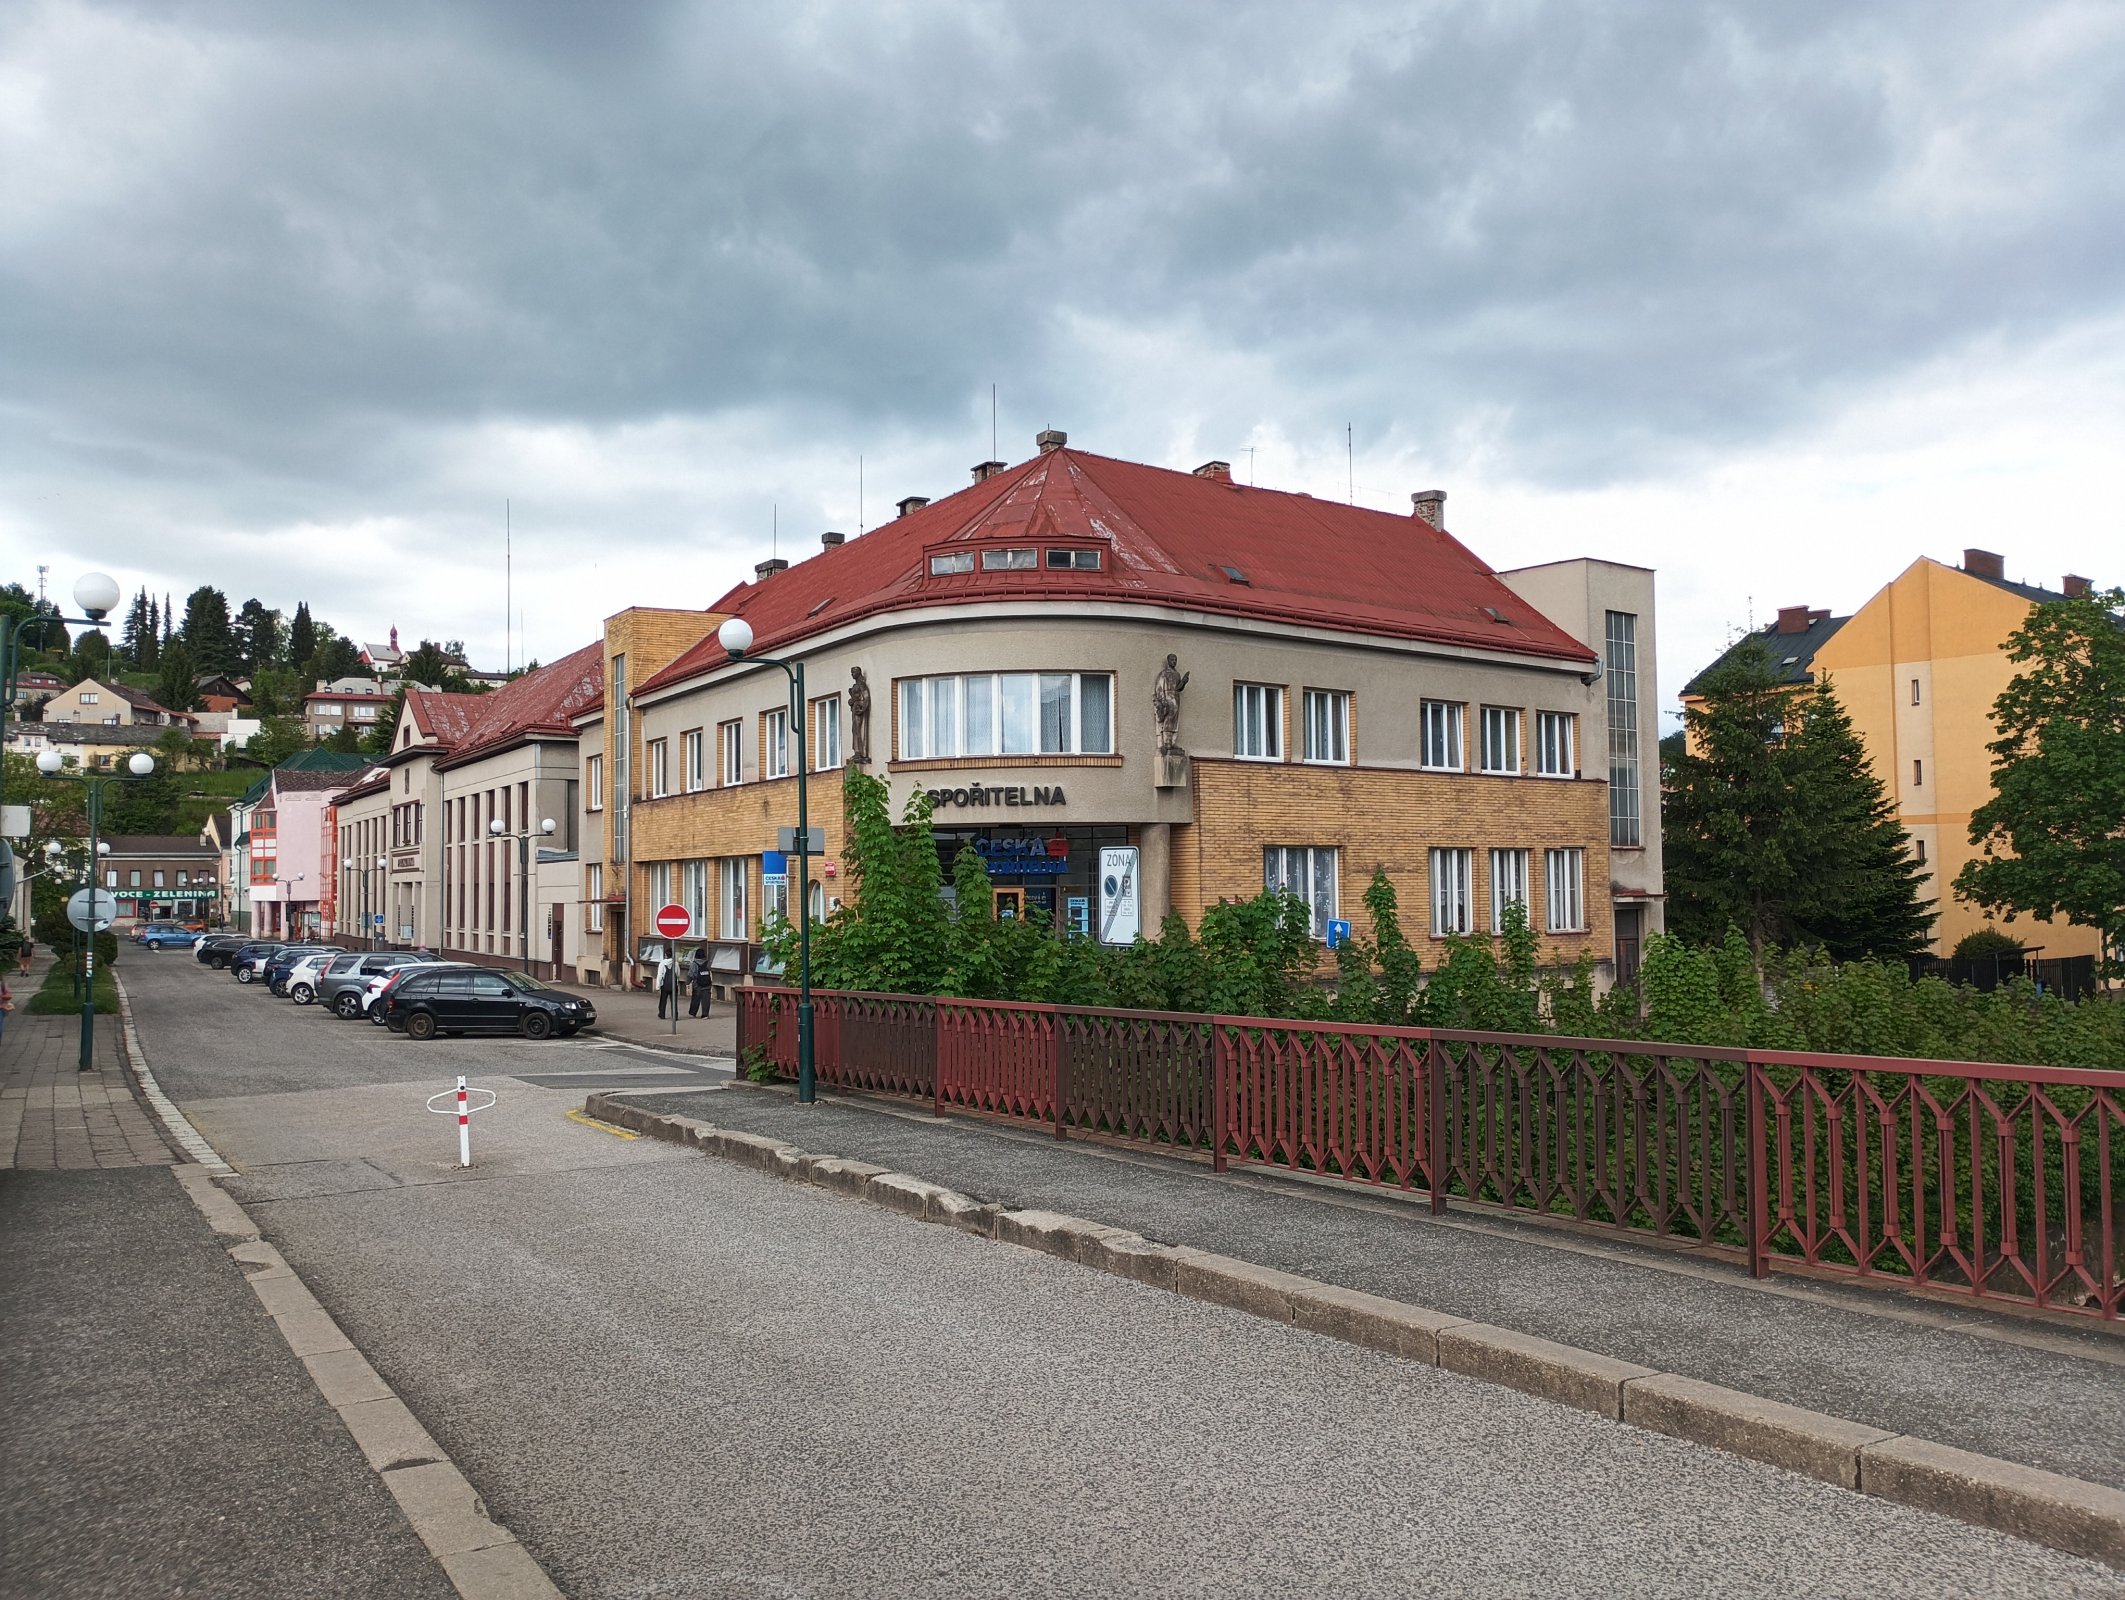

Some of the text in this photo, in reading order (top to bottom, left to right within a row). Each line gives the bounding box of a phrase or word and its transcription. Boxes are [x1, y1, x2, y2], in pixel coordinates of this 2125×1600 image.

[926, 782, 1067, 808] SPOŘITELNA
[1106, 851, 1132, 867] ZÓNA
[110, 890, 143, 898] VOCE
[153, 890, 216, 898] ZELENINA
